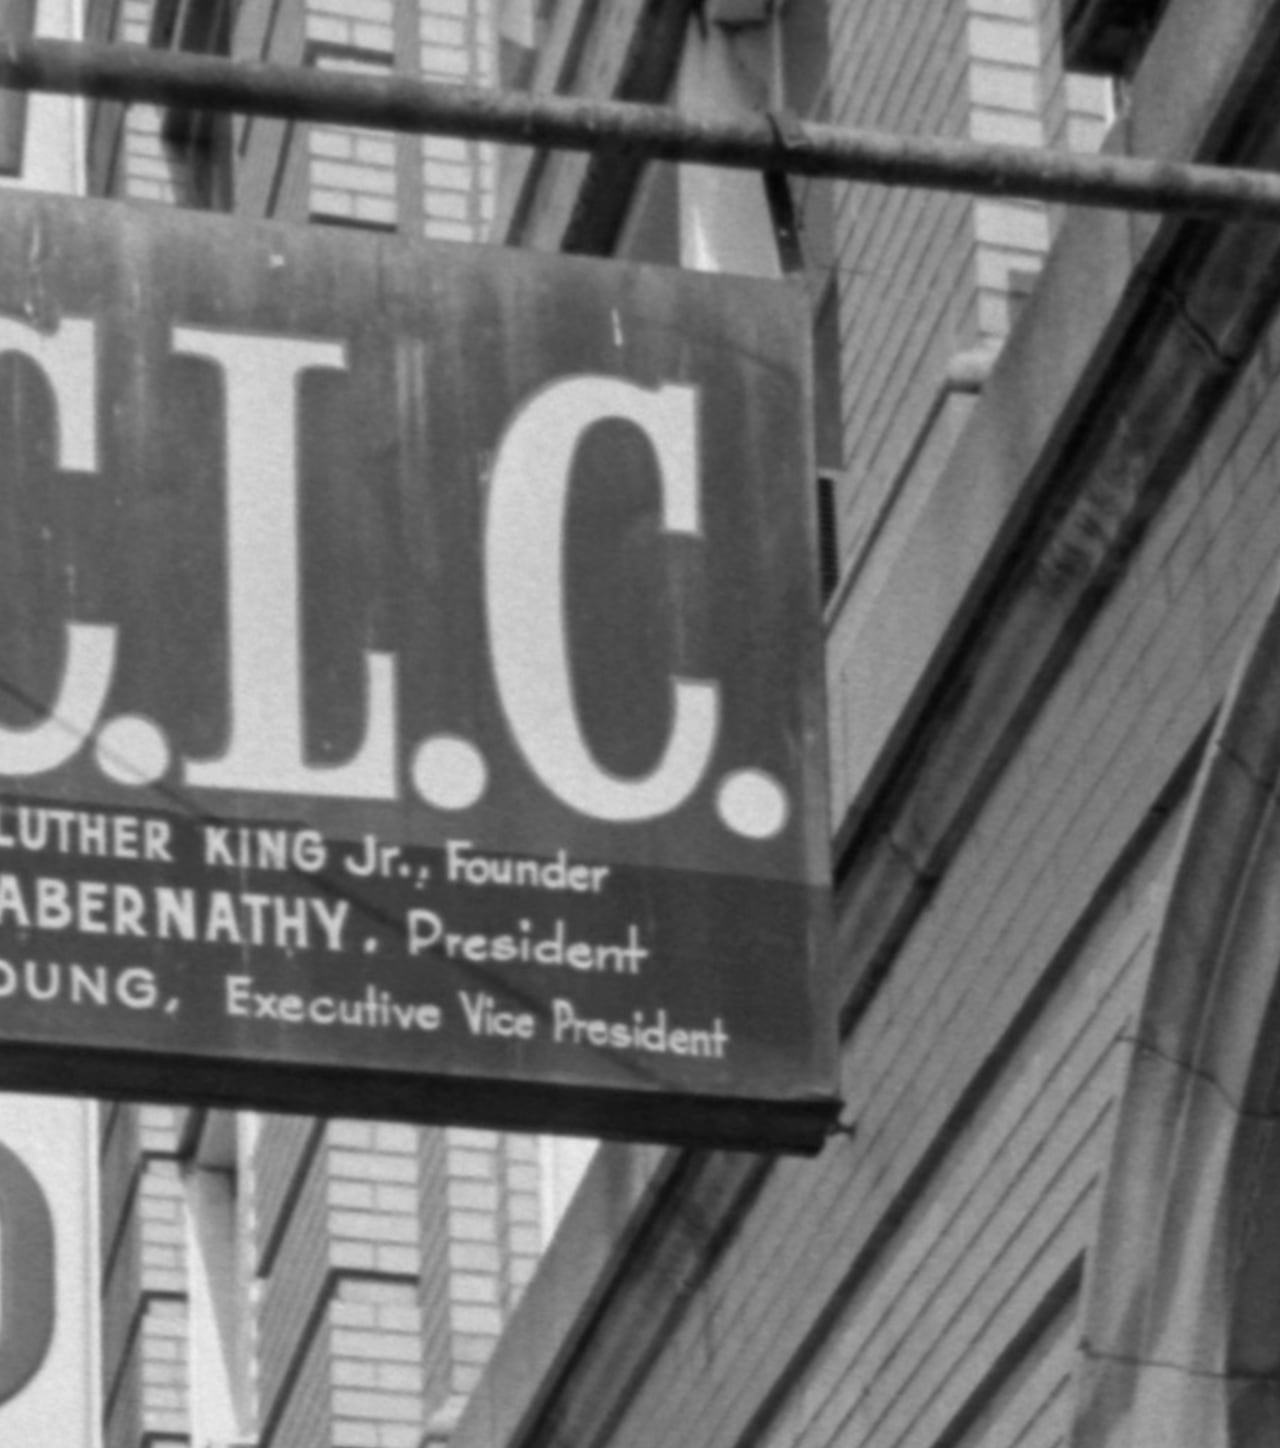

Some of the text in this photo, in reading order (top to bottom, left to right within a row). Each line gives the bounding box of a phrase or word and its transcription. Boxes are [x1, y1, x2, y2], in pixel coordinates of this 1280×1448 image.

[205, 826, 328, 873] KING
[446, 840, 610, 894] Founder
[406, 910, 650, 975] President
[224, 974, 443, 1031] Executive
[458, 988, 536, 1041] Vice
[552, 999, 730, 1060] President
